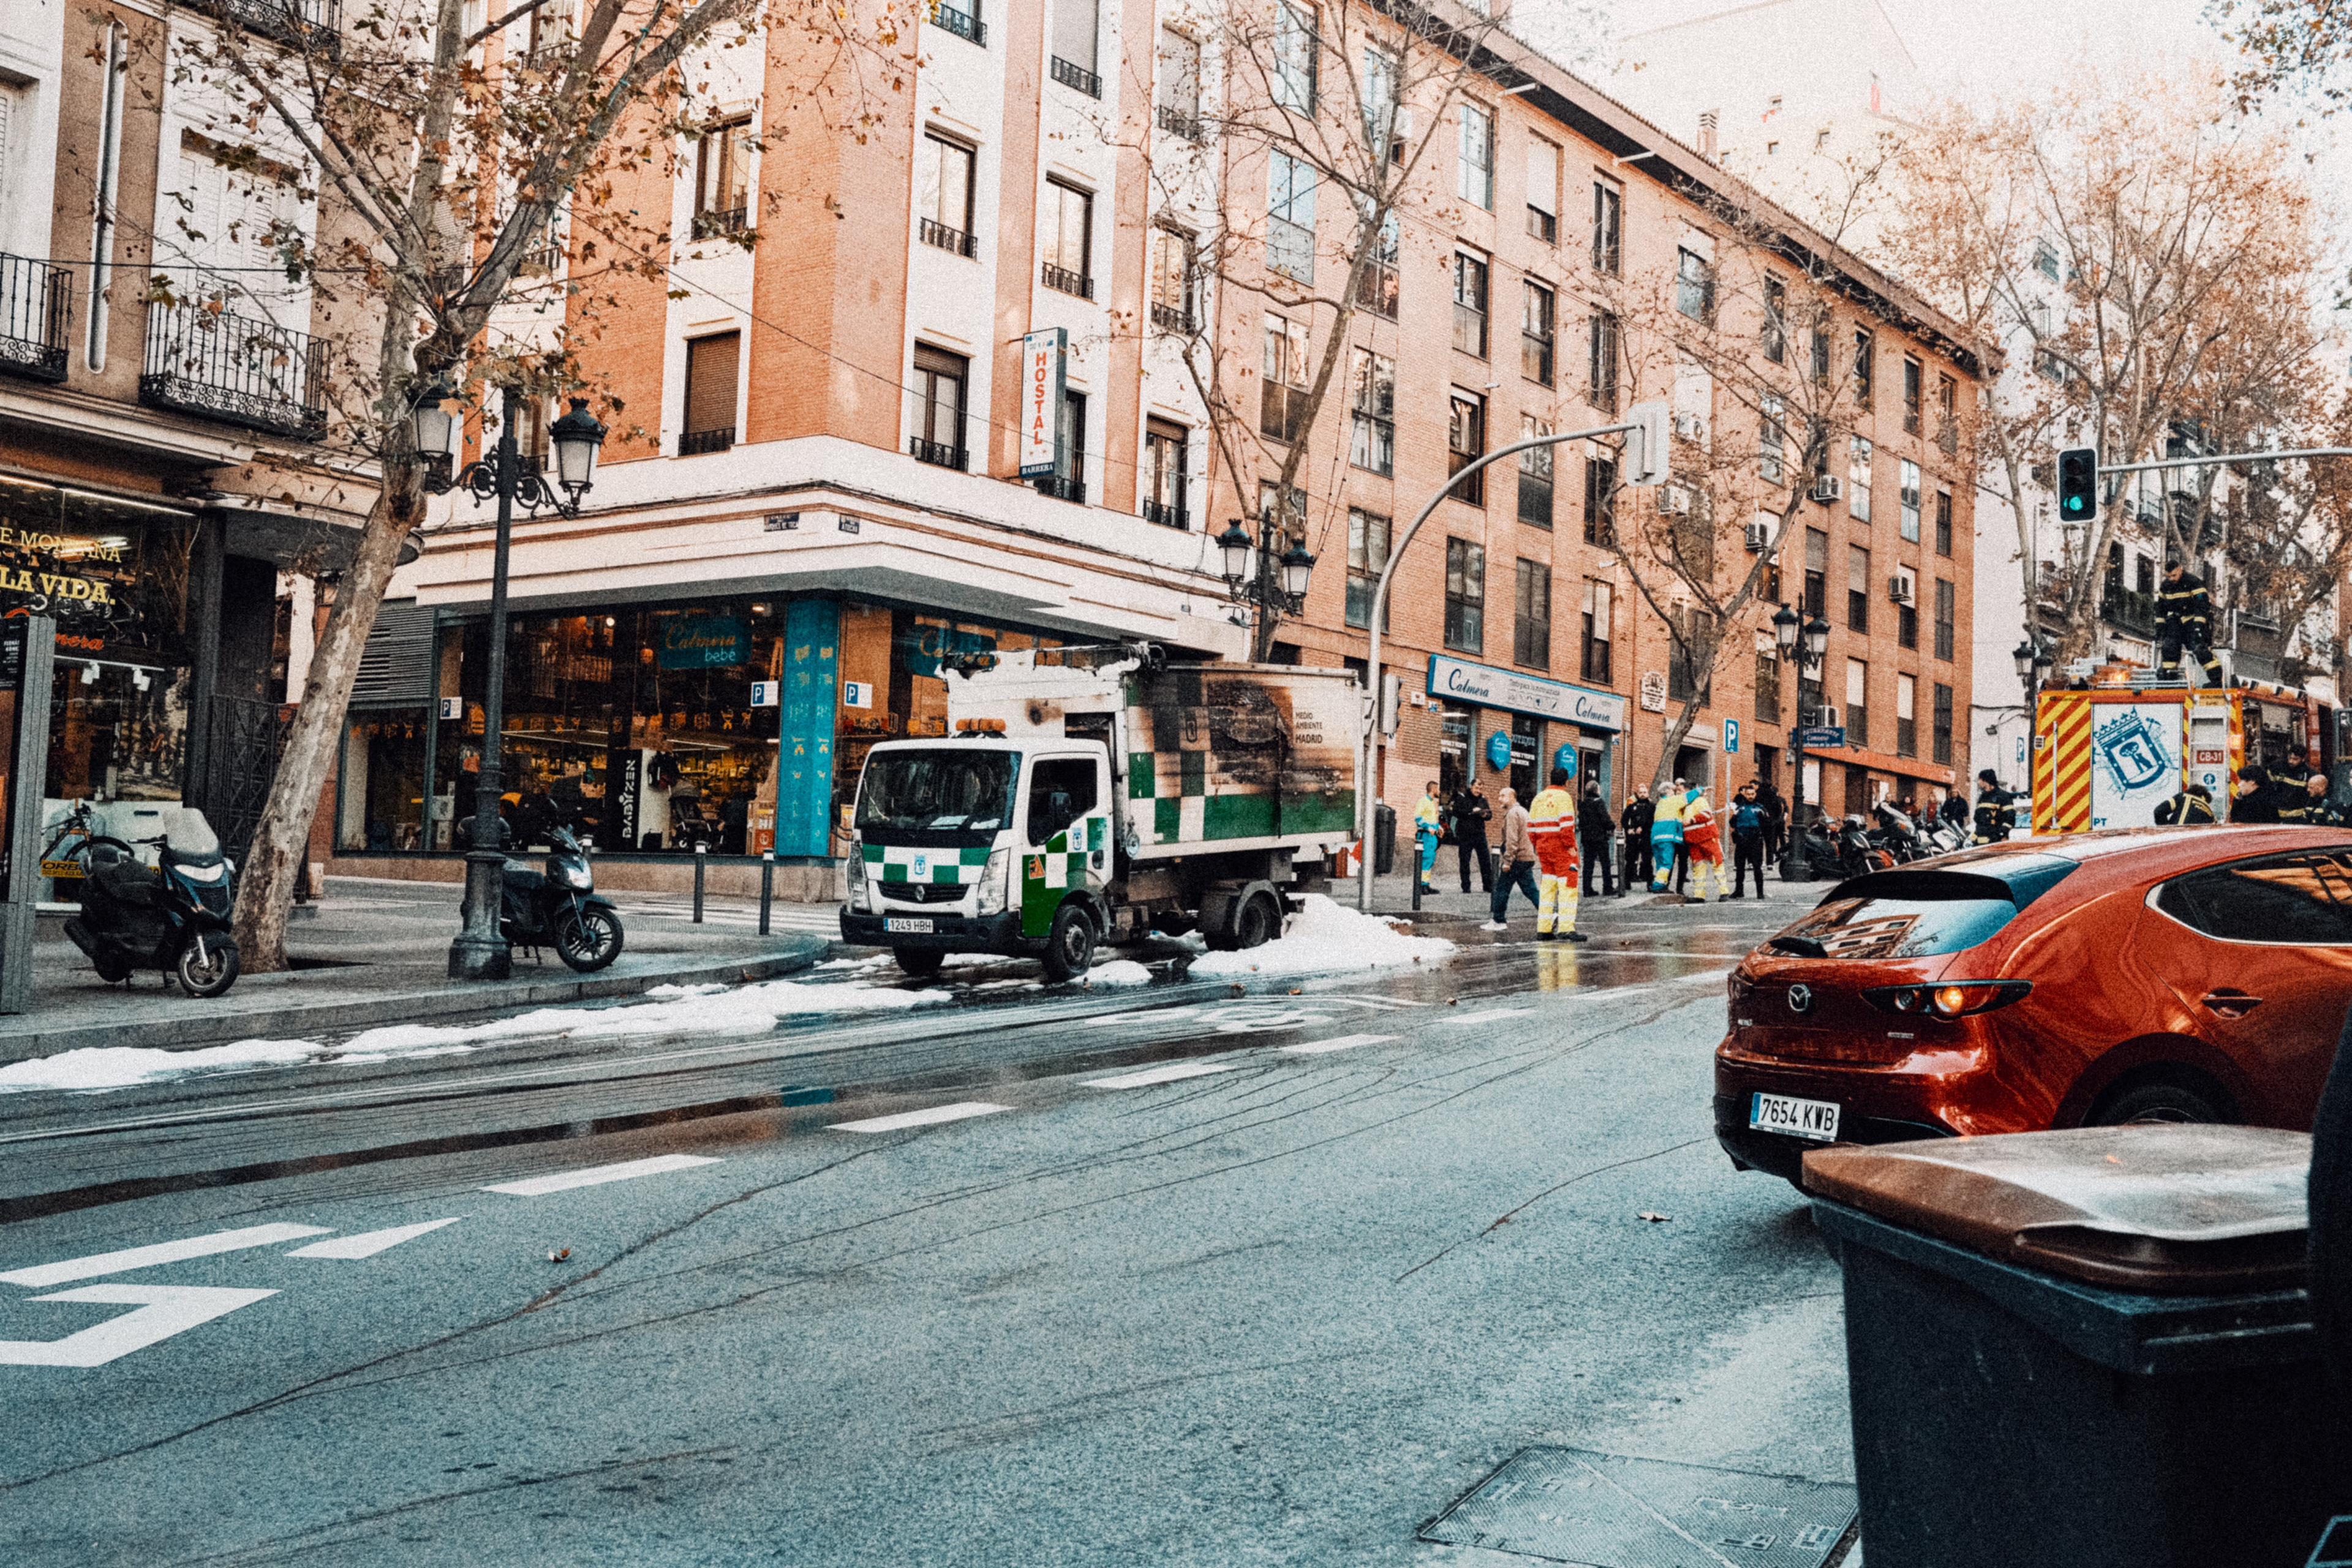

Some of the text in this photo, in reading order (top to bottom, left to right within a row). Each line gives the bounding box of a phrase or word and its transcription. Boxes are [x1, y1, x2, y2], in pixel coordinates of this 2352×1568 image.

[1033, 352, 1047, 445] HOSTAL
[1022, 463, 1053, 475] BARRERA
[20, 530, 122, 563] MONAÑA
[0, 567, 116, 605] LA VIDA.
[1449, 668, 1489, 697] Calmera
[755, 687, 762, 701] P
[848, 686, 856, 701] P
[443, 701, 450, 715] P
[1576, 696, 1610, 723] Calmera
[1295, 734, 1322, 744] MADRID
[1727, 723, 1736, 748] P
[2018, 739, 2024, 758] P
[2199, 752, 2222, 761] CB-31
[619, 760, 636, 838] BABYZEN
[2094, 818, 2107, 826] PT
[42, 862, 81, 871] ORB
[891, 920, 931, 931] 1249 HBH
[1761, 1098, 1834, 1132] 7654 KWB
